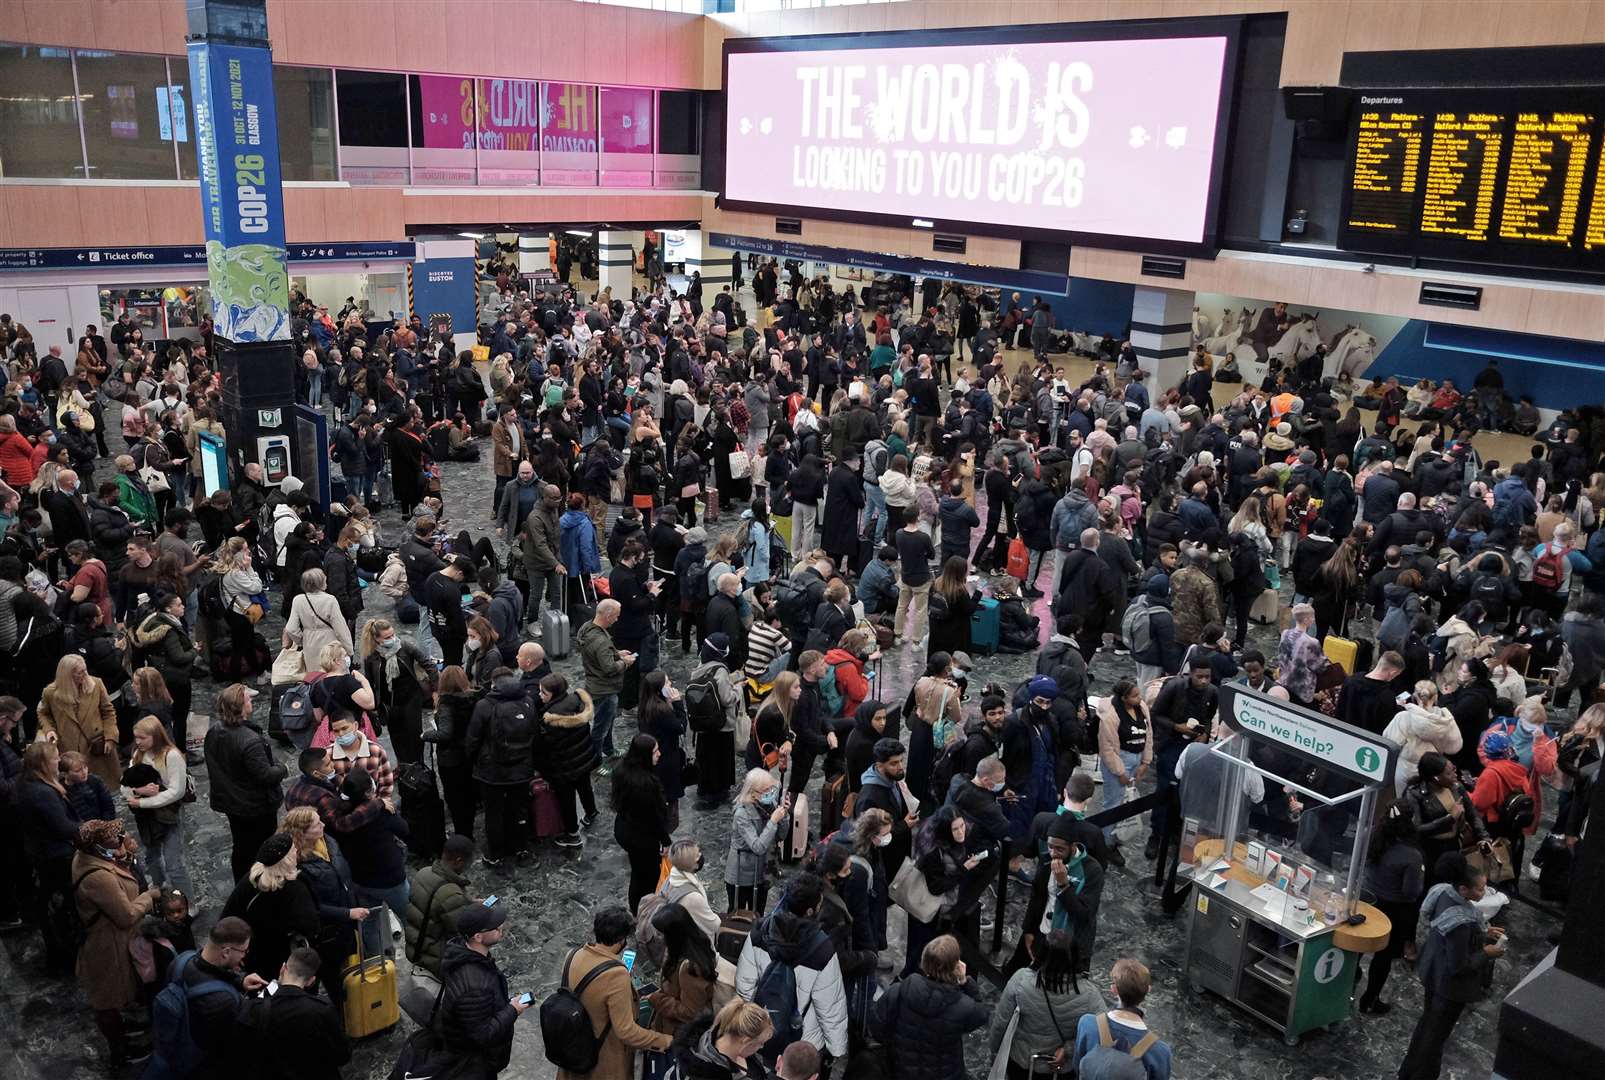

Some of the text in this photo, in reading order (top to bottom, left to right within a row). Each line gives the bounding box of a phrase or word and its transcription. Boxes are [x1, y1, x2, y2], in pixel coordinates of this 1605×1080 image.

[228, 59, 242, 81] 2021
[230, 81, 243, 101] NOV
[1361, 96, 1403, 105] Departures
[232, 101, 243, 110] 12
[796, 58, 1095, 150] THE WORLD IS
[234, 116, 244, 134] OCT
[246, 104, 260, 145] GLASGOW
[1516, 123, 1578, 132] Watford Junction
[1554, 113, 1586, 122] Platform
[196, 103, 209, 183] THANK YOU
[236, 135, 245, 145] 31
[207, 121, 220, 203] TRAVELLING
[793, 144, 1087, 209] LOOKING TO YOU COP26
[234, 153, 269, 234] COP26
[213, 206, 222, 233] FOR
[1525, 233, 1567, 241] Overground
[104, 251, 154, 260] Ticket office
[1250, 703, 1266, 713] London
[1266, 710, 1298, 724] Northwestern
[1239, 710, 1334, 756] Can we help?
